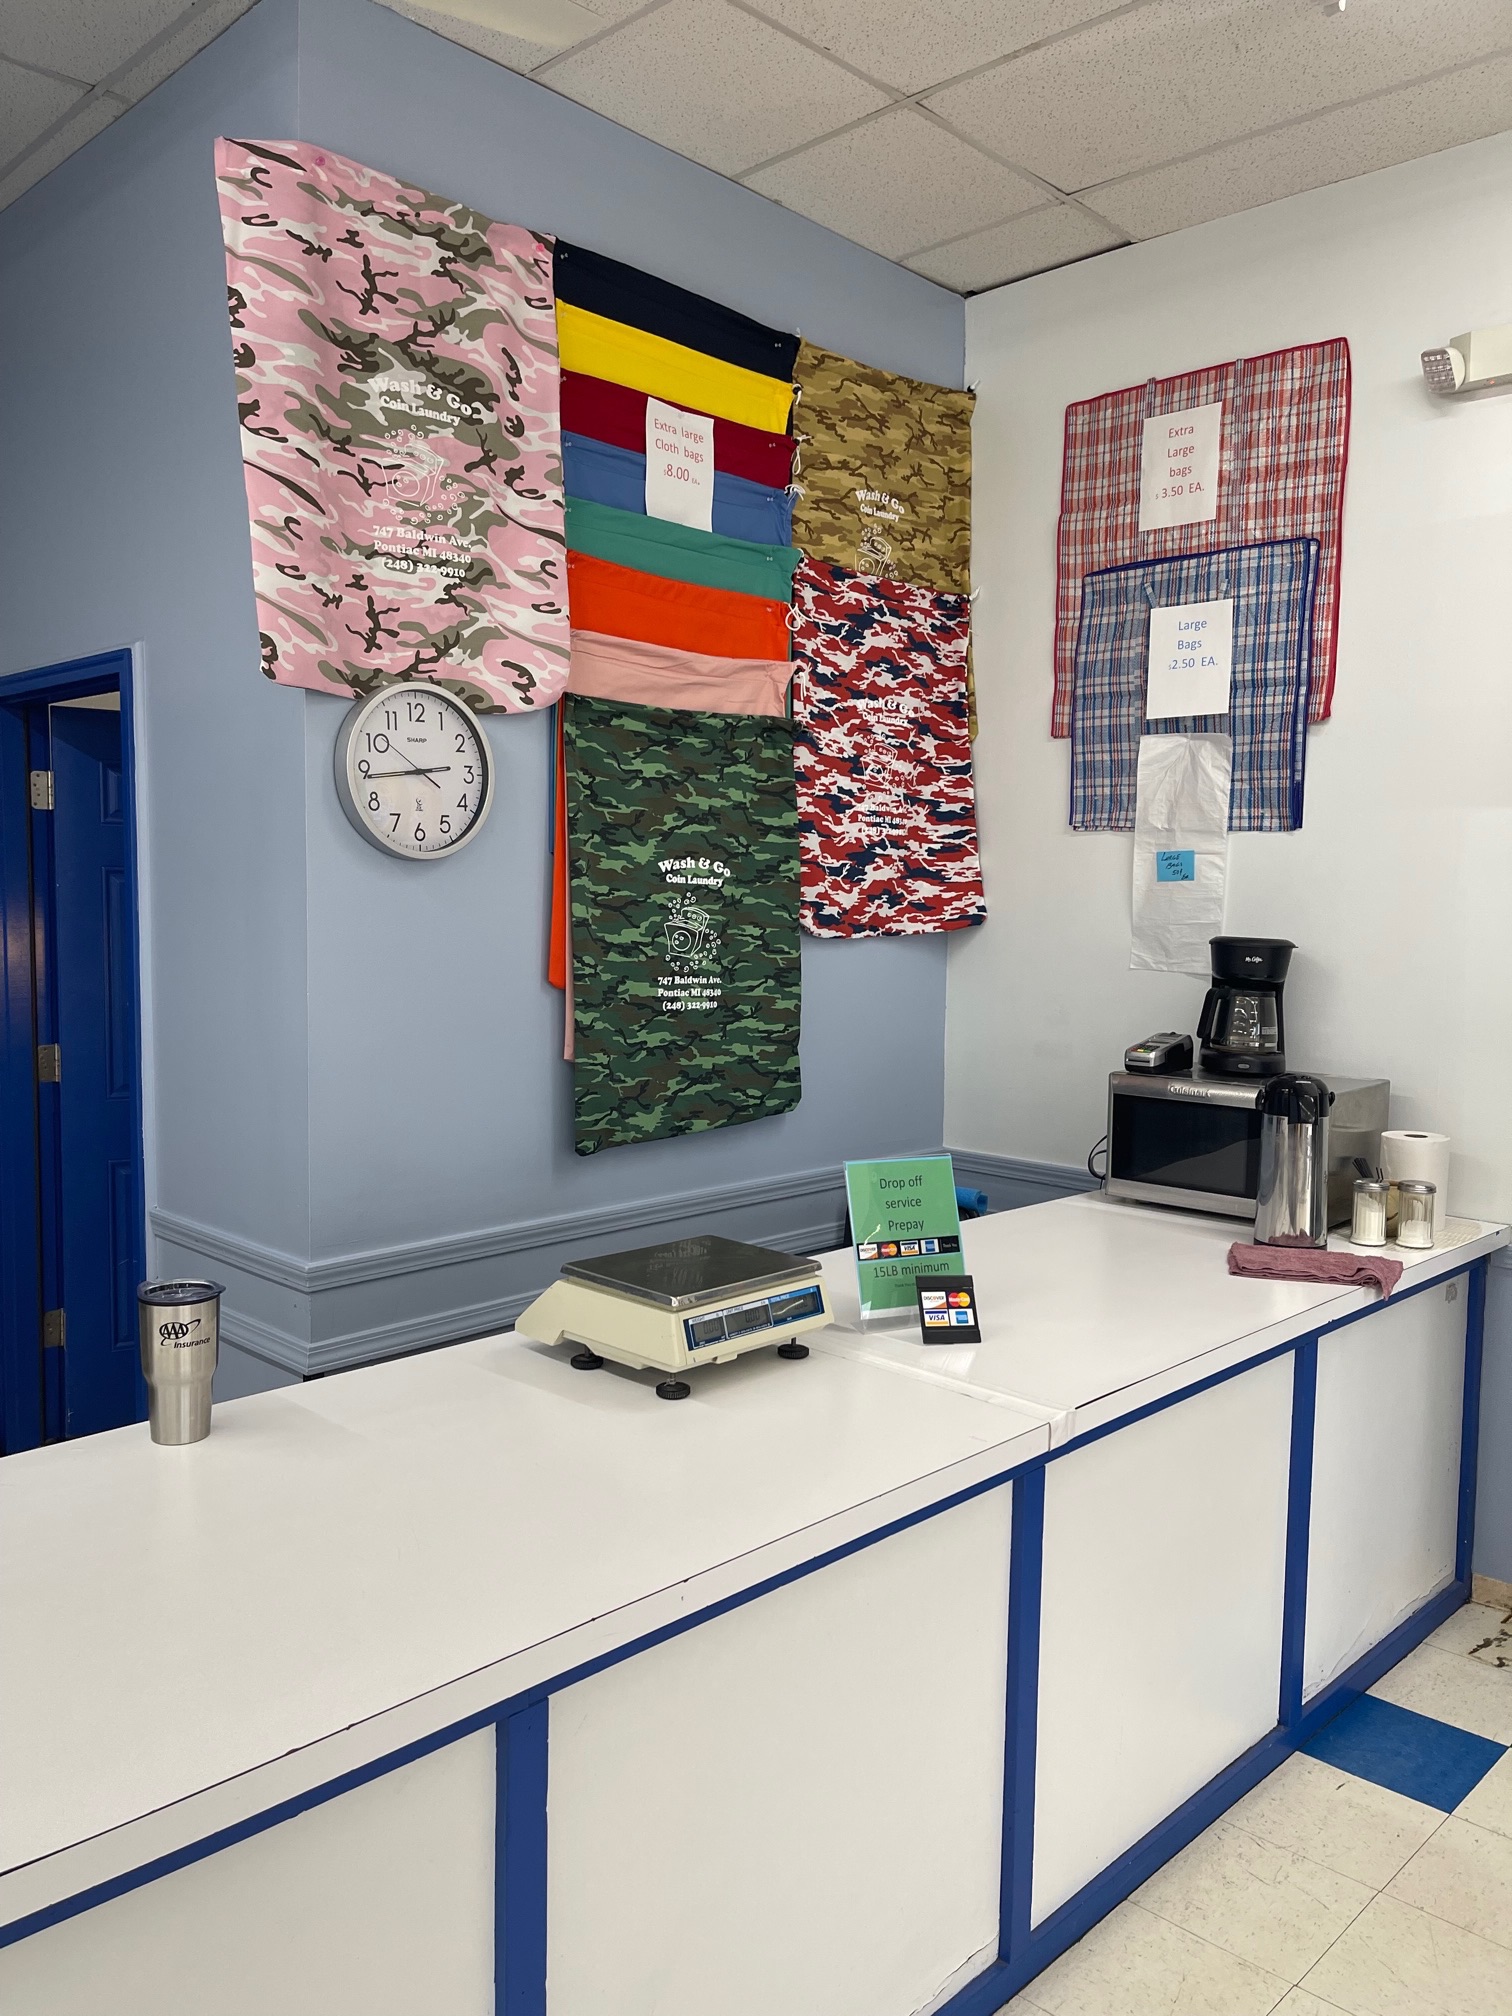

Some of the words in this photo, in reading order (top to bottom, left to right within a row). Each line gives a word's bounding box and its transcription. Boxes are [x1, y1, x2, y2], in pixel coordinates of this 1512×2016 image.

[367, 377, 423, 394] Wash
[426, 384, 442, 400] &
[446, 393, 472, 416] Go
[380, 395, 410, 412] Coin
[412, 403, 461, 427] Laundry
[654, 418, 677, 435] Extra
[681, 426, 704, 444] large
[1168, 426, 1194, 438] Extra
[655, 438, 679, 455] Cloth
[684, 446, 704, 463] bags
[1167, 445, 1195, 458] Large
[664, 463, 690, 482] $8.00
[1169, 465, 1193, 478] bags
[1188, 482, 1205, 494] EA.
[855, 489, 881, 502] Wash
[881, 492, 890, 505] &
[891, 498, 905, 514] Go
[860, 503, 873, 515] Coin
[873, 507, 900, 523] Laundry
[372, 525, 393, 539] 747
[396, 526, 447, 544] Baldwin
[449, 534, 472, 549] Ave.
[374, 540, 419, 556] Pontiac
[422, 548, 437, 559] MI
[439, 551, 471, 564] 48340
[381, 557, 414, 573] (248)
[1178, 620, 1208, 632] Large
[1177, 640, 1203, 651] Bags
[1168, 657, 1195, 671] $2.50
[1201, 656, 1219, 667] EA.
[385, 711, 398, 731] 11
[407, 702, 425, 723] 12
[438, 711, 443, 731] 1
[366, 733, 390, 753] 10
[455, 734, 465, 753] 2
[358, 759, 371, 779] 9
[463, 765, 475, 784] 3
[368, 791, 380, 811] 8
[456, 793, 468, 811] 4
[389, 813, 401, 832] 7
[414, 822, 426, 841] 6
[440, 815, 450, 833] 5
[658, 857, 695, 873] Wash
[698, 857, 711, 869] &
[713, 861, 731, 877] Go
[666, 873, 686, 884] Coin
[687, 875, 724, 887] Laundry
[657, 976, 673, 986] 747
[674, 976, 707, 985] Baldwin
[708, 975, 722, 984] Ave.
[657, 988, 690, 997] Pontiac
[690, 988, 701, 997] MI
[702, 988, 722, 997] 48340
[662, 1000, 685, 1011] (248)
[686, 1001, 718, 1010] 322-9910
[879, 1177, 905, 1191] Drop
[909, 1175, 923, 1188] off
[885, 1197, 922, 1210] service
[888, 1219, 925, 1233] Prepay
[874, 1265, 898, 1278] 15LB
[901, 1262, 950, 1275] minimum
[163, 1323, 186, 1339] AAA
[174, 1337, 211, 1349] Insurance
